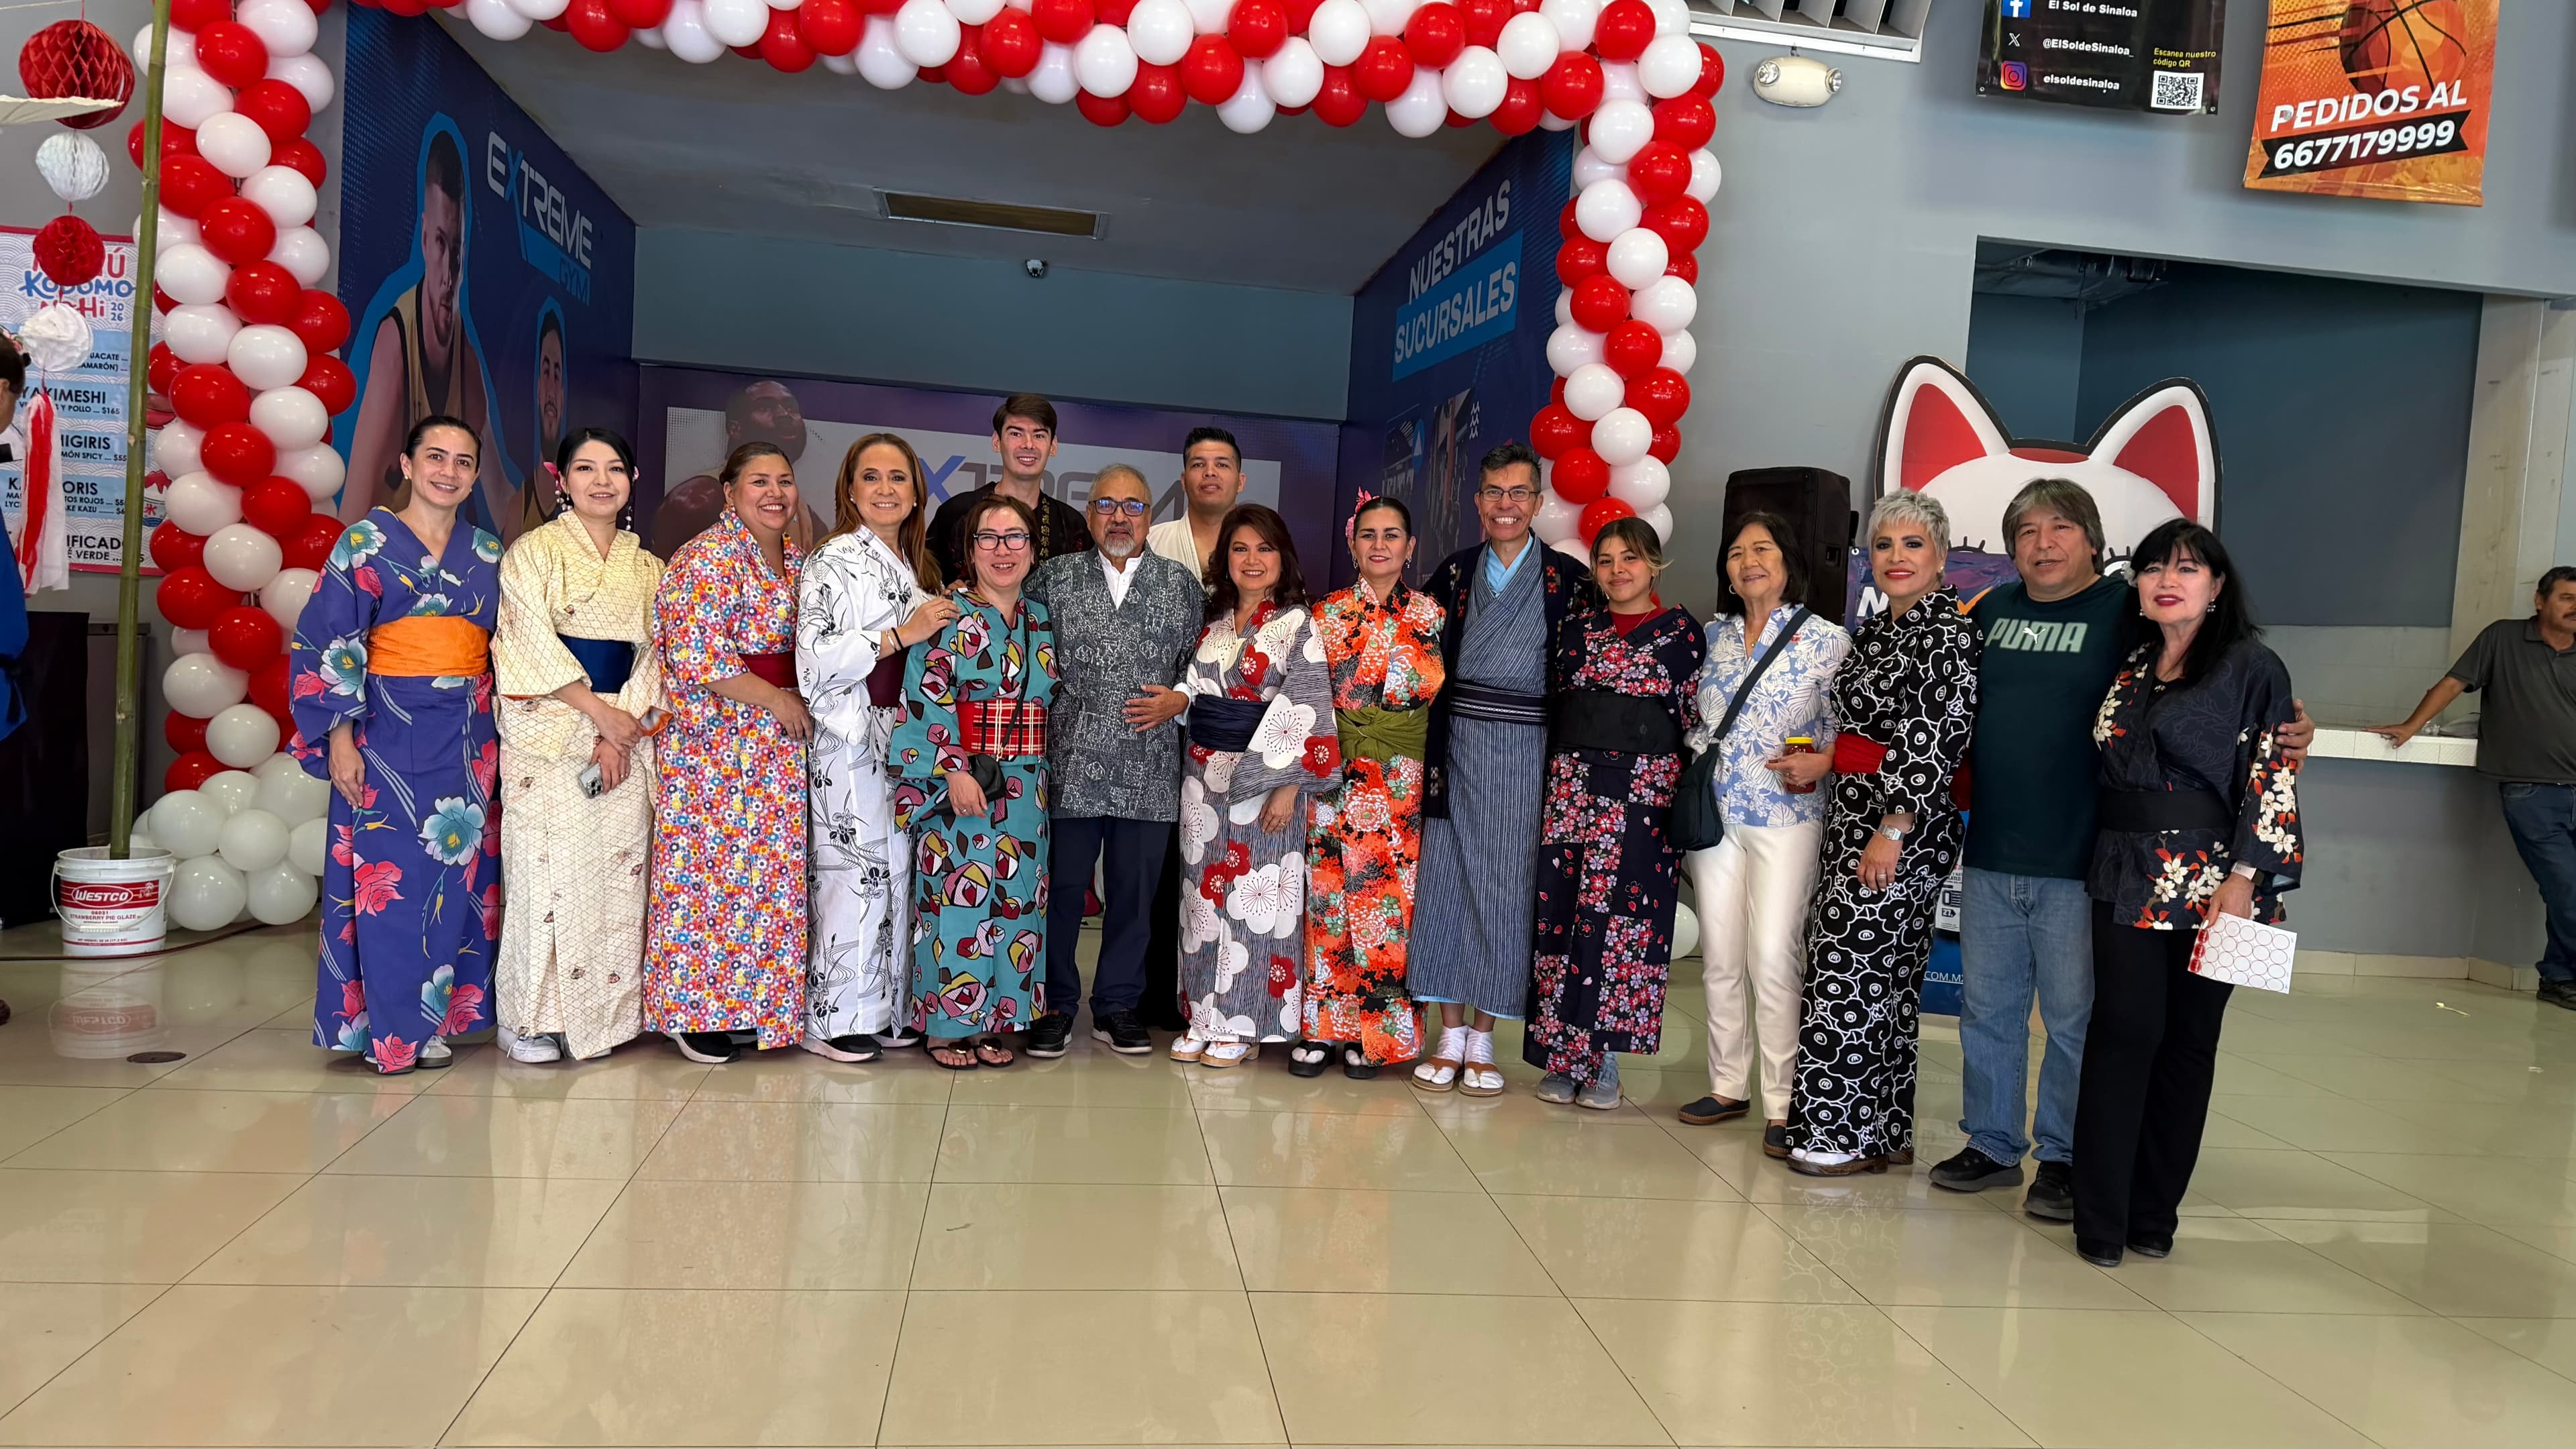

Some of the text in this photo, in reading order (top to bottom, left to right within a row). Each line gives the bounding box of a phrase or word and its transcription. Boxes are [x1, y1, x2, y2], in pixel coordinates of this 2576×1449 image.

[2048, 0, 2138, 17] El Sol de Sinaloa
[2154, 48, 2216, 58] Escanea nuestro
[2153, 58, 2177, 68] código
[2043, 74, 2120, 90] elsoldesinaloa
[2270, 79, 2467, 132] PEDIDOS AL
[2274, 120, 2455, 170] 6677179999
[487, 131, 592, 270] EXTREME
[1409, 178, 1511, 305] NUESTRAS
[559, 258, 590, 307] GYM
[111, 303, 124, 311] 20
[1395, 260, 1517, 364] SUCURSALES
[111, 313, 123, 321] 26
[90, 352, 119, 360] UACATE
[80, 362, 118, 372] AMARÓN)
[60, 435, 111, 450] IGIRIS
[61, 450, 80, 458] MÓN
[115, 498, 125, 506] $5
[67, 535, 123, 549] IFICAD
[76, 550, 110, 560] VERDE
[1985, 617, 2088, 653] PUMA
[74, 890, 129, 902] WESTCO
